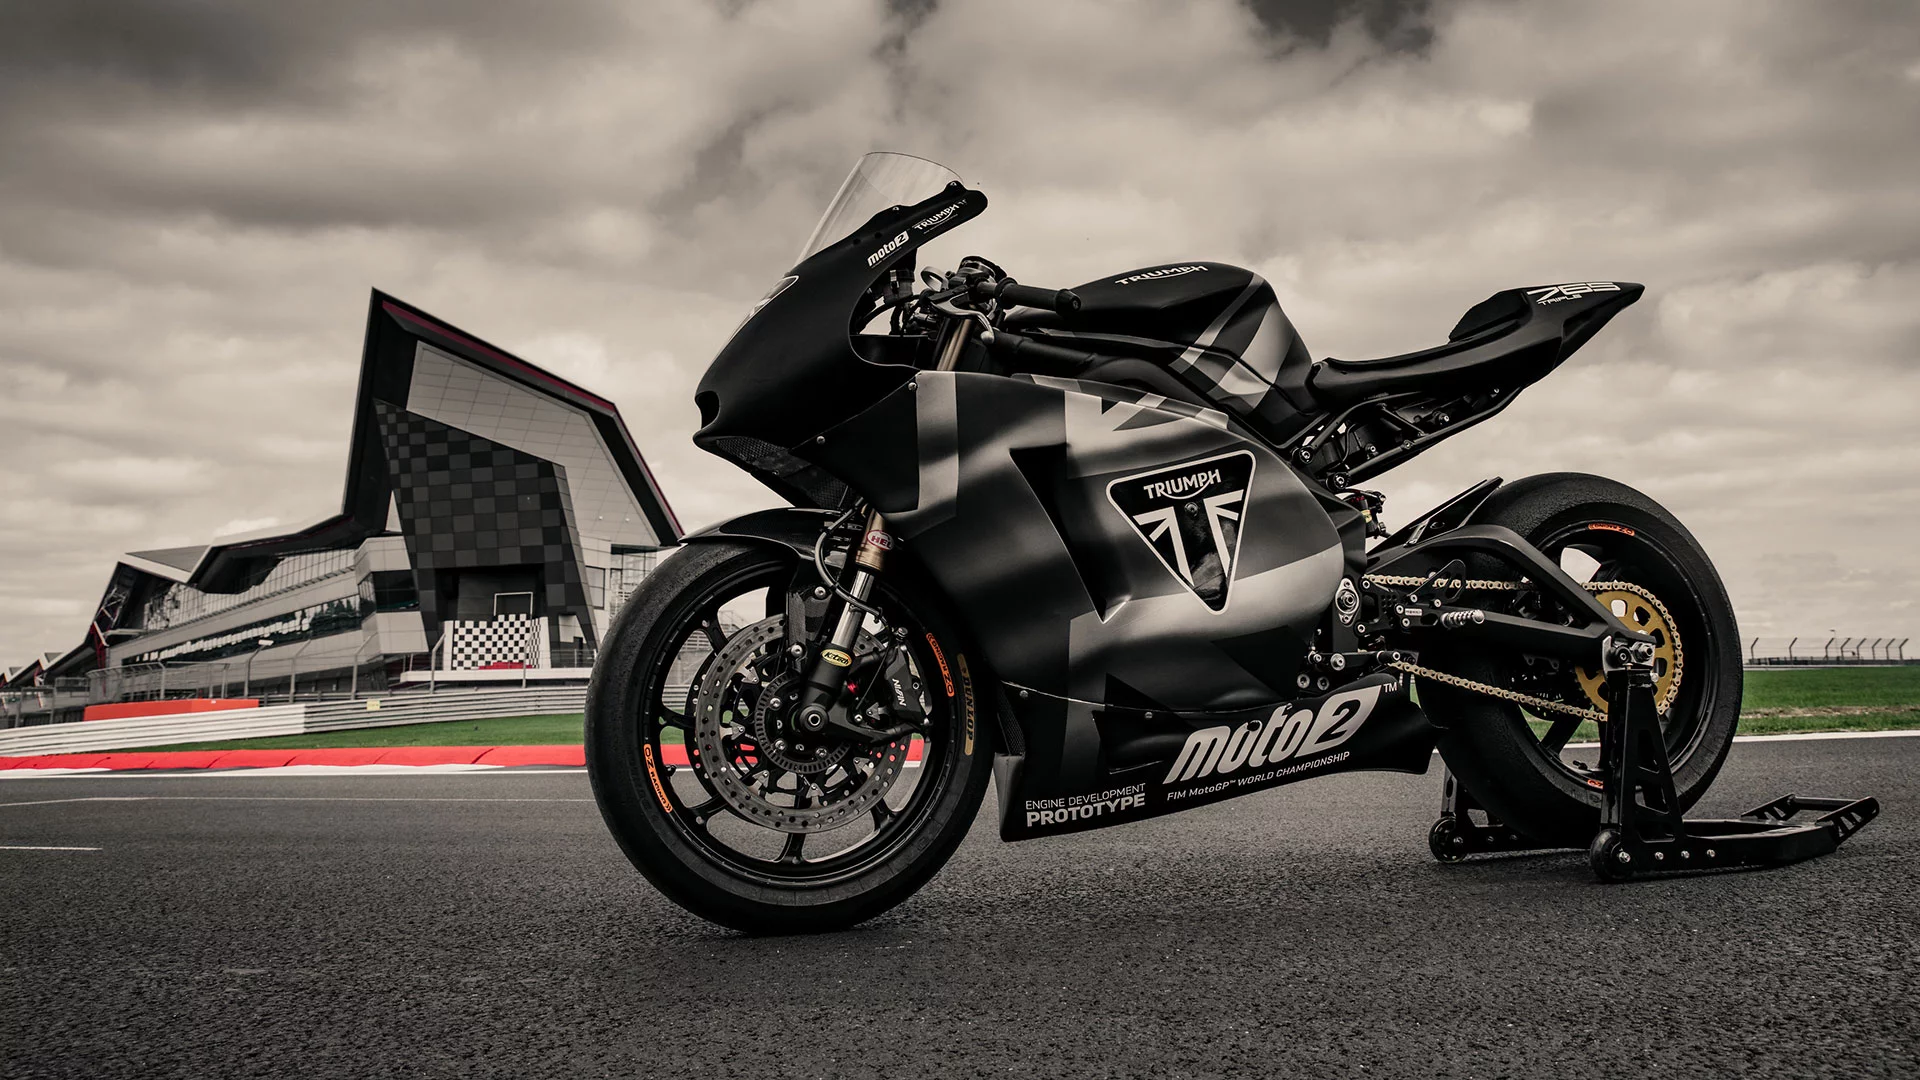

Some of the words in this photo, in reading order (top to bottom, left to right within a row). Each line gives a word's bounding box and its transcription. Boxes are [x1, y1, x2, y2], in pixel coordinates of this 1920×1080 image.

[914, 203, 960, 230] TRIUMPH
[867, 230, 910, 267] moto2
[1114, 265, 1209, 285] TRIUMPH
[1526, 282, 1621, 302] 765
[1143, 468, 1222, 499] TRIUMPH
[962, 677, 975, 741] DUNLOP
[1163, 684, 1382, 785] moto2
[650, 771, 668, 804] RACING
[1167, 789, 1187, 801] FIM
[1237, 771, 1275, 787] WORLD
[1275, 750, 1350, 778] CHAMPIONSHIP
[1025, 797, 1065, 811] ENGINE
[1068, 782, 1146, 806] DEVELOPMENT
[1026, 792, 1146, 827] PROTOTYPE
